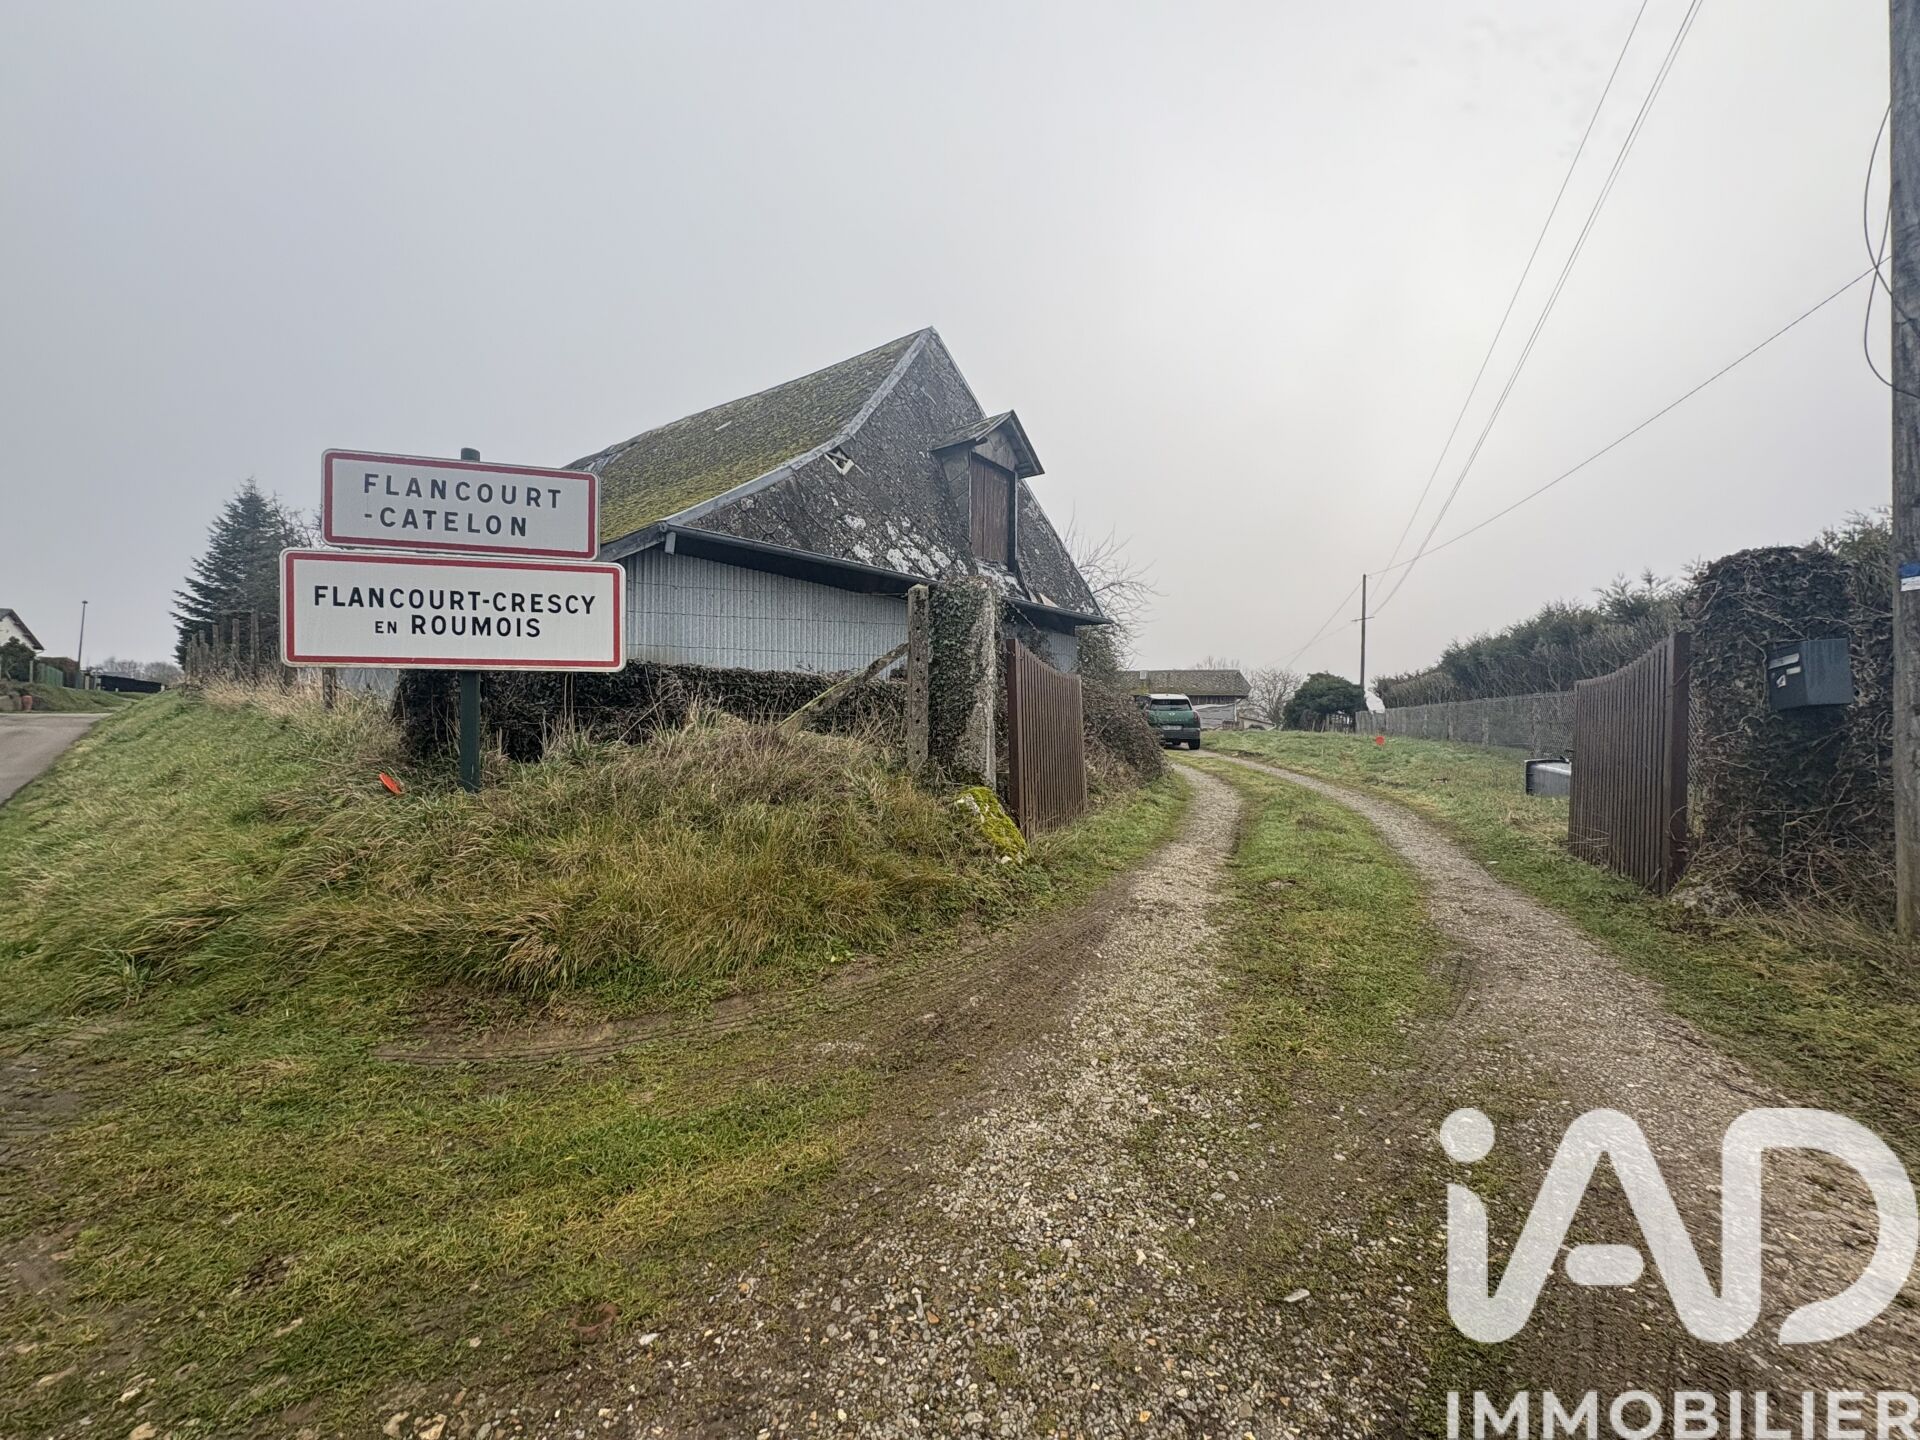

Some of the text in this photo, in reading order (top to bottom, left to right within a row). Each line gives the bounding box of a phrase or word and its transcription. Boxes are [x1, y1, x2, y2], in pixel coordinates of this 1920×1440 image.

[364, 473, 562, 509] FLANCOURT
[364, 507, 528, 537] -CATELON
[314, 585, 596, 615] FLANCOURT-CRESCY
[375, 614, 541, 638] EN ROUMOIS
